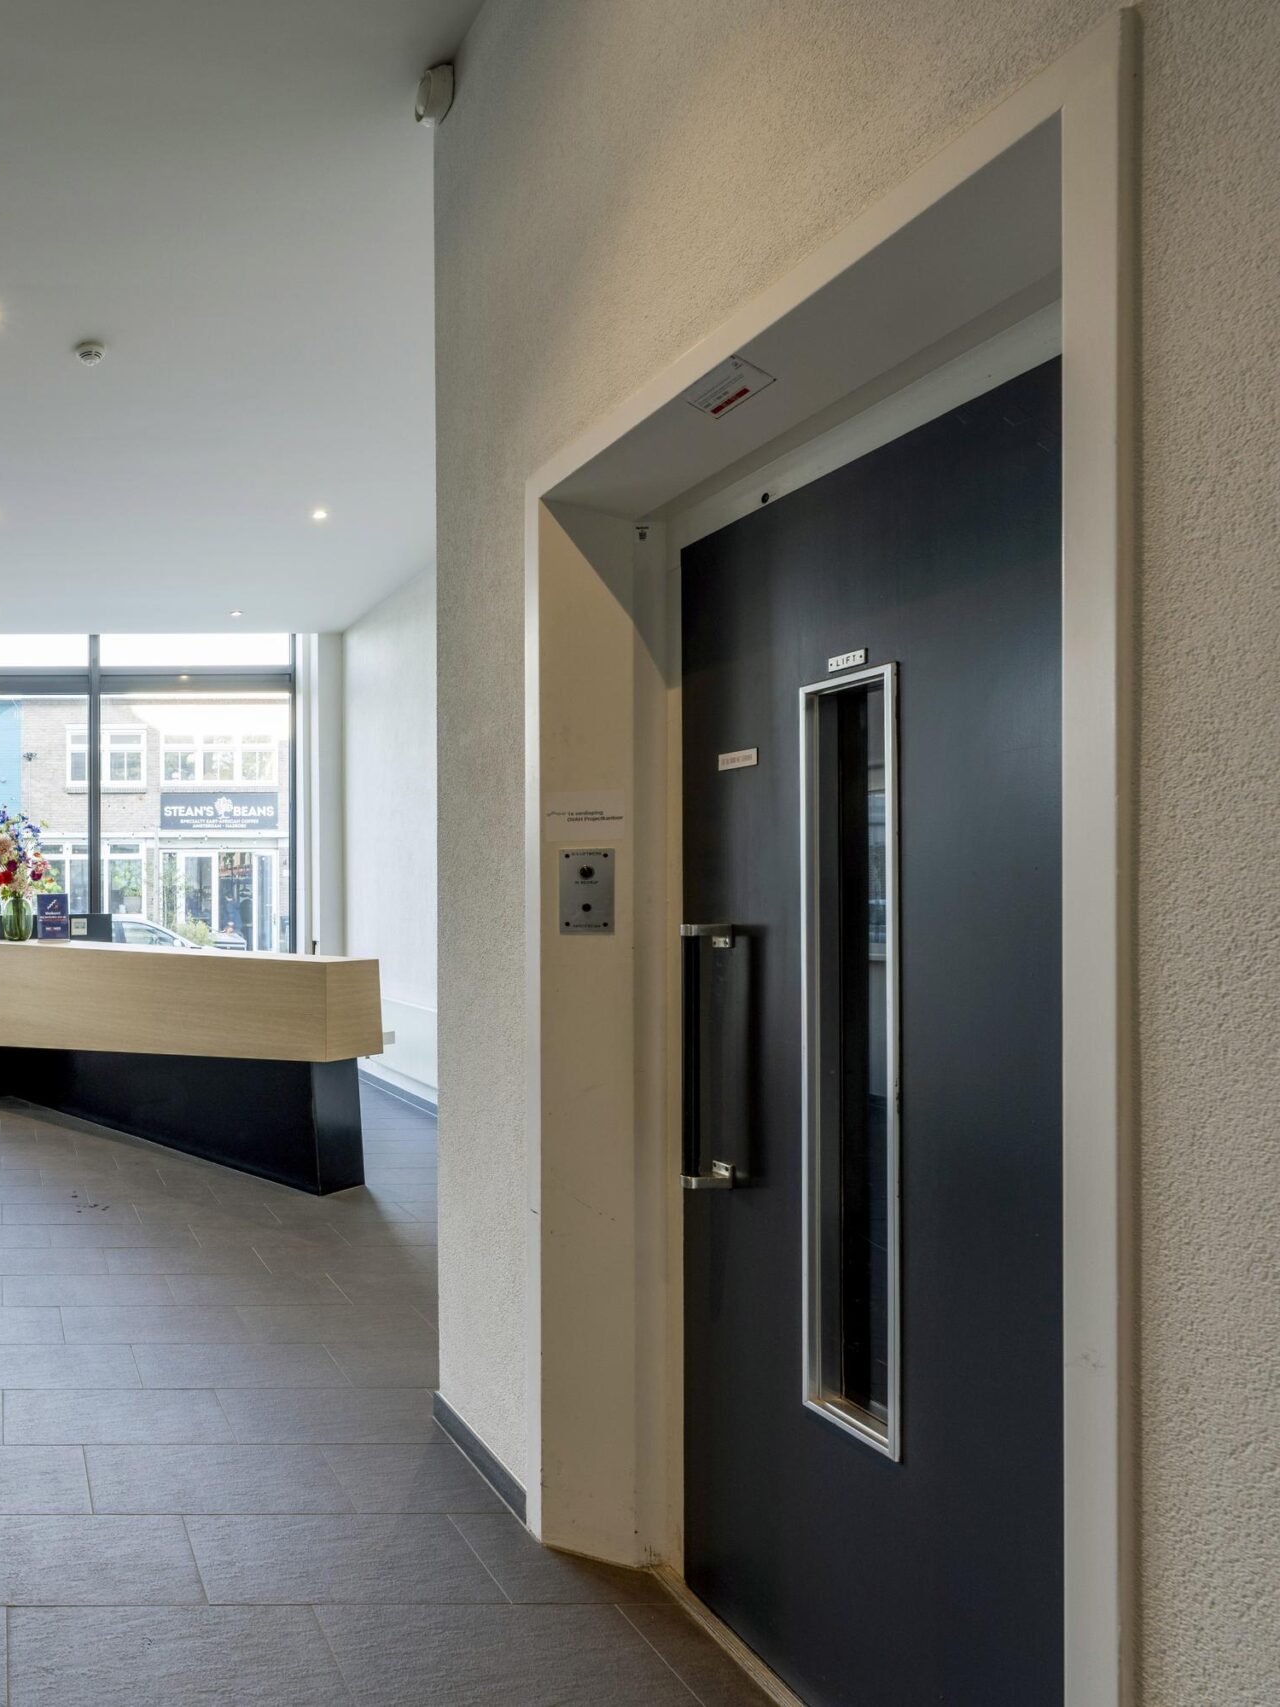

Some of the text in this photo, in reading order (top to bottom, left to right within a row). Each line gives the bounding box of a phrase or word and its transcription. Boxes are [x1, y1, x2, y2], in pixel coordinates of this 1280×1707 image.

[836, 655, 856, 667] LIFT
[164, 806, 275, 817] STEAN'S BEANS
